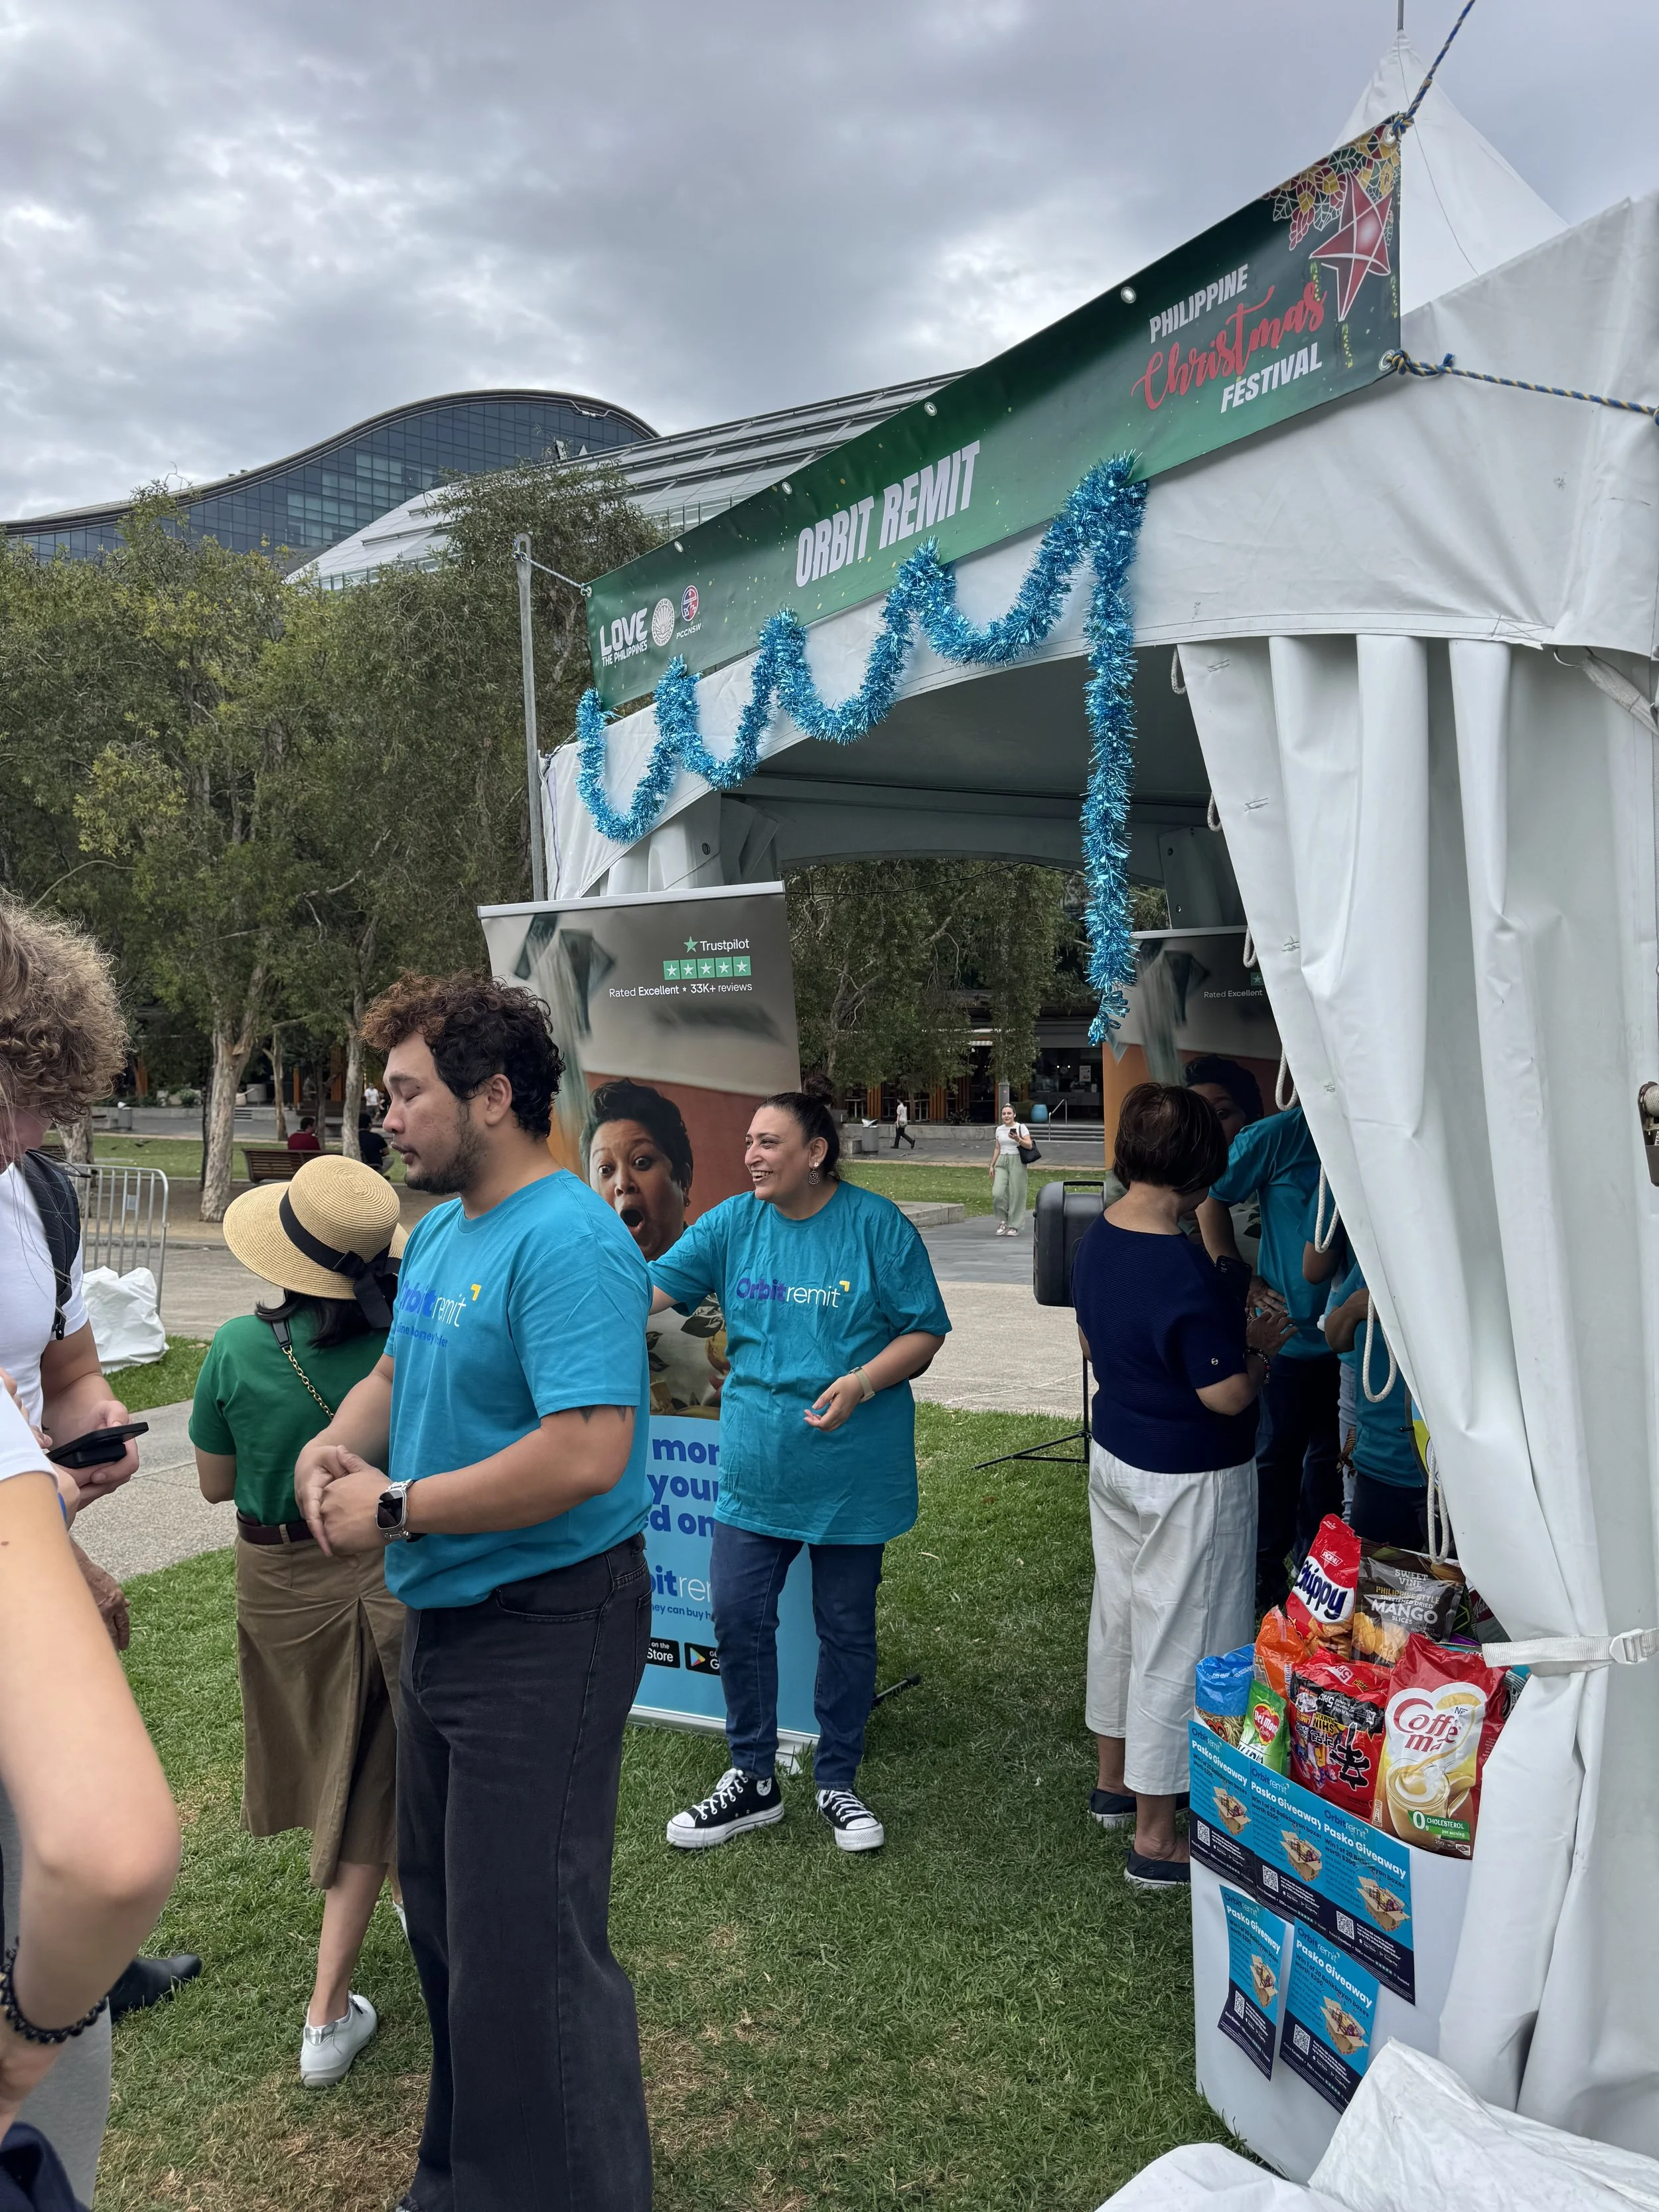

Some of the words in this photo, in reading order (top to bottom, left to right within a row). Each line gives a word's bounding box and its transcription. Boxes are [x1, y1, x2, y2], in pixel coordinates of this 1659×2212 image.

[1149, 263, 1248, 343] PHILIPPINE
[1131, 285, 1327, 410] Christmas
[1220, 342, 1322, 413] FESTIVAL
[796, 495, 875, 587] ORBIT
[879, 440, 980, 550] REMIT
[600, 608, 648, 657] LOVE
[676, 623, 701, 640] PCCNSW
[602, 654, 613, 666] THE
[614, 640, 648, 662] PHILIPPINES
[700, 938, 750, 952] Trustpilot
[609, 987, 636, 997] Rated
[638, 985, 680, 996] Excellent
[691, 984, 716, 994] 33K+
[718, 982, 753, 992] reviews
[737, 1278, 841, 1308] Orbitremit
[652, 1439, 720, 1465] mor
[678, 1512, 715, 1538] on
[1395, 1569, 1428, 1581] SWEET
[1399, 1577, 1421, 1588] VINE
[1376, 1586, 1415, 1599] PHILIPPINE
[1416, 1594, 1440, 1604] STYLE
[1380, 1595, 1413, 1604] SWEETENED
[1414, 1601, 1433, 1609] DRIED
[668, 1606, 685, 1615] can
[687, 1607, 703, 1621] buy
[705, 1611, 711, 1619] h
[1371, 1599, 1438, 1625] MANGO
[1392, 1615, 1412, 1625] SLICES
[647, 1647, 674, 1662] Store
[710, 1659, 720, 1670] G
[1313, 1718, 1334, 1733] SHIN
[1192, 1740, 1212, 1759] Pasko
[1213, 1755, 1248, 1787] Giveaway
[1251, 1781, 1277, 1802] Pasko
[1252, 1768, 1287, 1795] Orbitremit
[1252, 1795, 1261, 1804] Win
[1252, 1802, 1266, 1814] worth
[1324, 1810, 1366, 1840] Orbitremit
[1413, 1810, 1425, 1830] 0
[1427, 1817, 1465, 1829] CHOLESTEROL
[1324, 1823, 1354, 1847] Pasko
[1356, 1841, 1406, 1880] Giveaway
[1325, 1846, 1341, 1859] worth
[1325, 1838, 1336, 1848] Win
[1346, 1850, 1353, 1859] 20
[1388, 1873, 1406, 1889] boxes
[1226, 1905, 1250, 1925] Pasko
[1250, 1920, 1281, 1954] Giveaway
[1297, 1927, 1337, 1963] Orbitremit
[1295, 1960, 1310, 1976] worth
[1296, 1939, 1325, 1967] Pasko
[1325, 1963, 1372, 2009] Giveaway
[1295, 1953, 1306, 1964] Win
[1309, 1963, 1315, 1972] of
[1315, 1968, 1321, 1977] 20
[1321, 1973, 1352, 2004] Balikbayan
[1352, 2000, 1369, 2018] boxes
